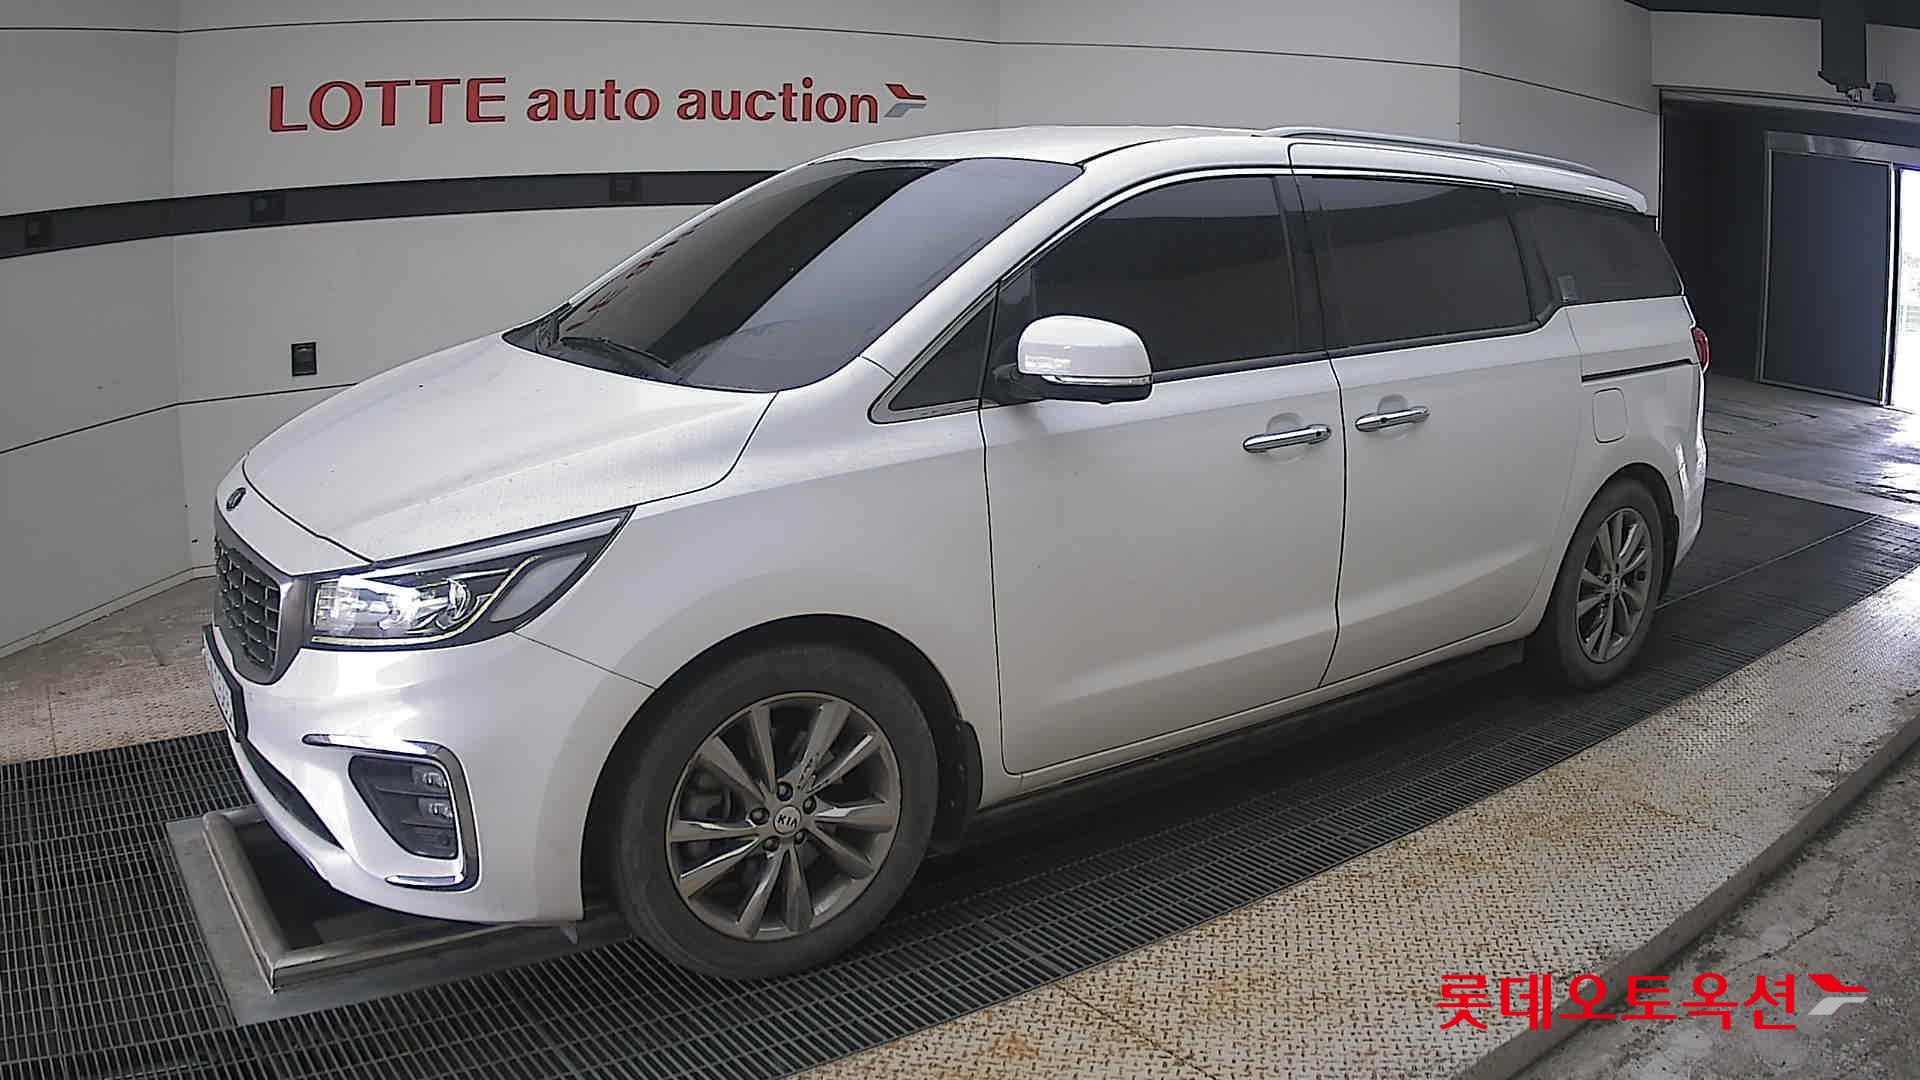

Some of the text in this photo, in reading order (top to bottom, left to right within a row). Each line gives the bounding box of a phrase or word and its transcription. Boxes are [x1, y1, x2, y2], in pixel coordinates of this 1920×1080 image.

[270, 77, 879, 132] LOTTE auto auction
[777, 814, 797, 827] KIA
